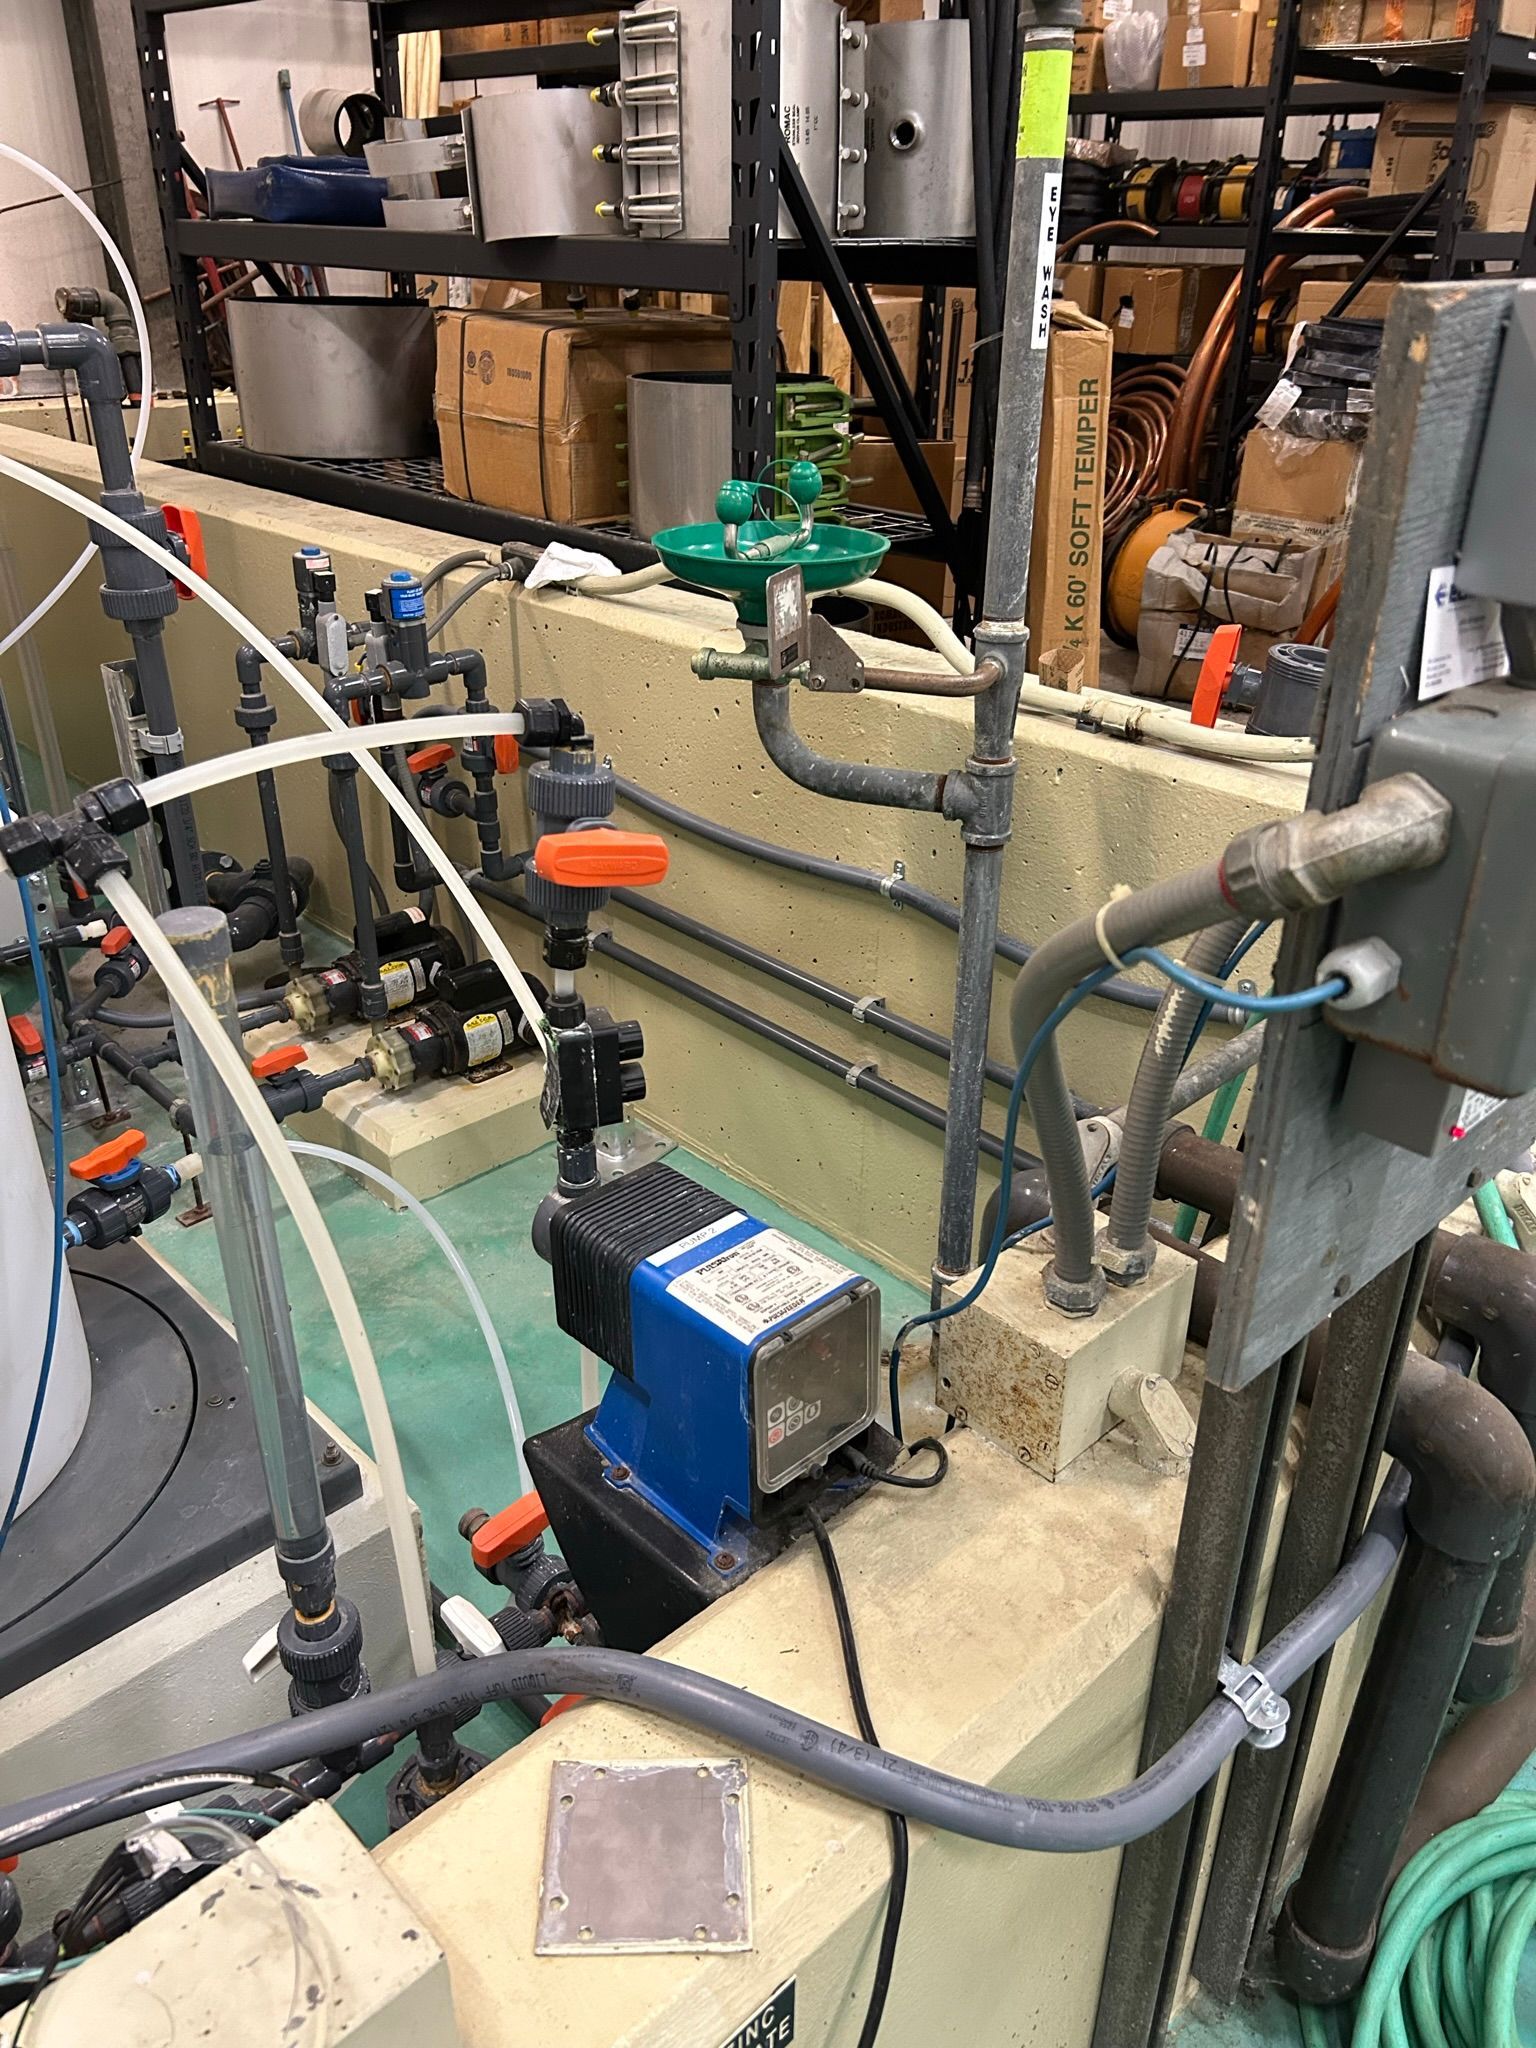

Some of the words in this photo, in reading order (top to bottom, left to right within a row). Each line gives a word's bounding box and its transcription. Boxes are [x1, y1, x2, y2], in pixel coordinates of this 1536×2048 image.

[1047, 187, 1058, 241] EYE
[1038, 265, 1051, 338] WASH
[1074, 378, 1099, 487] TEMPER
[1069, 498, 1092, 567] SOFT
[1067, 574, 1087, 609] 60'
[1064, 615, 1084, 632] K
[679, 1231, 709, 1250] PUMP
[708, 1226, 718, 1236] 2
[510, 1673, 548, 1690] LIQUID
[830, 1737, 871, 1761] (3/4)
[882, 1756, 898, 1772] 21
[727, 2004, 775, 2048] INC
